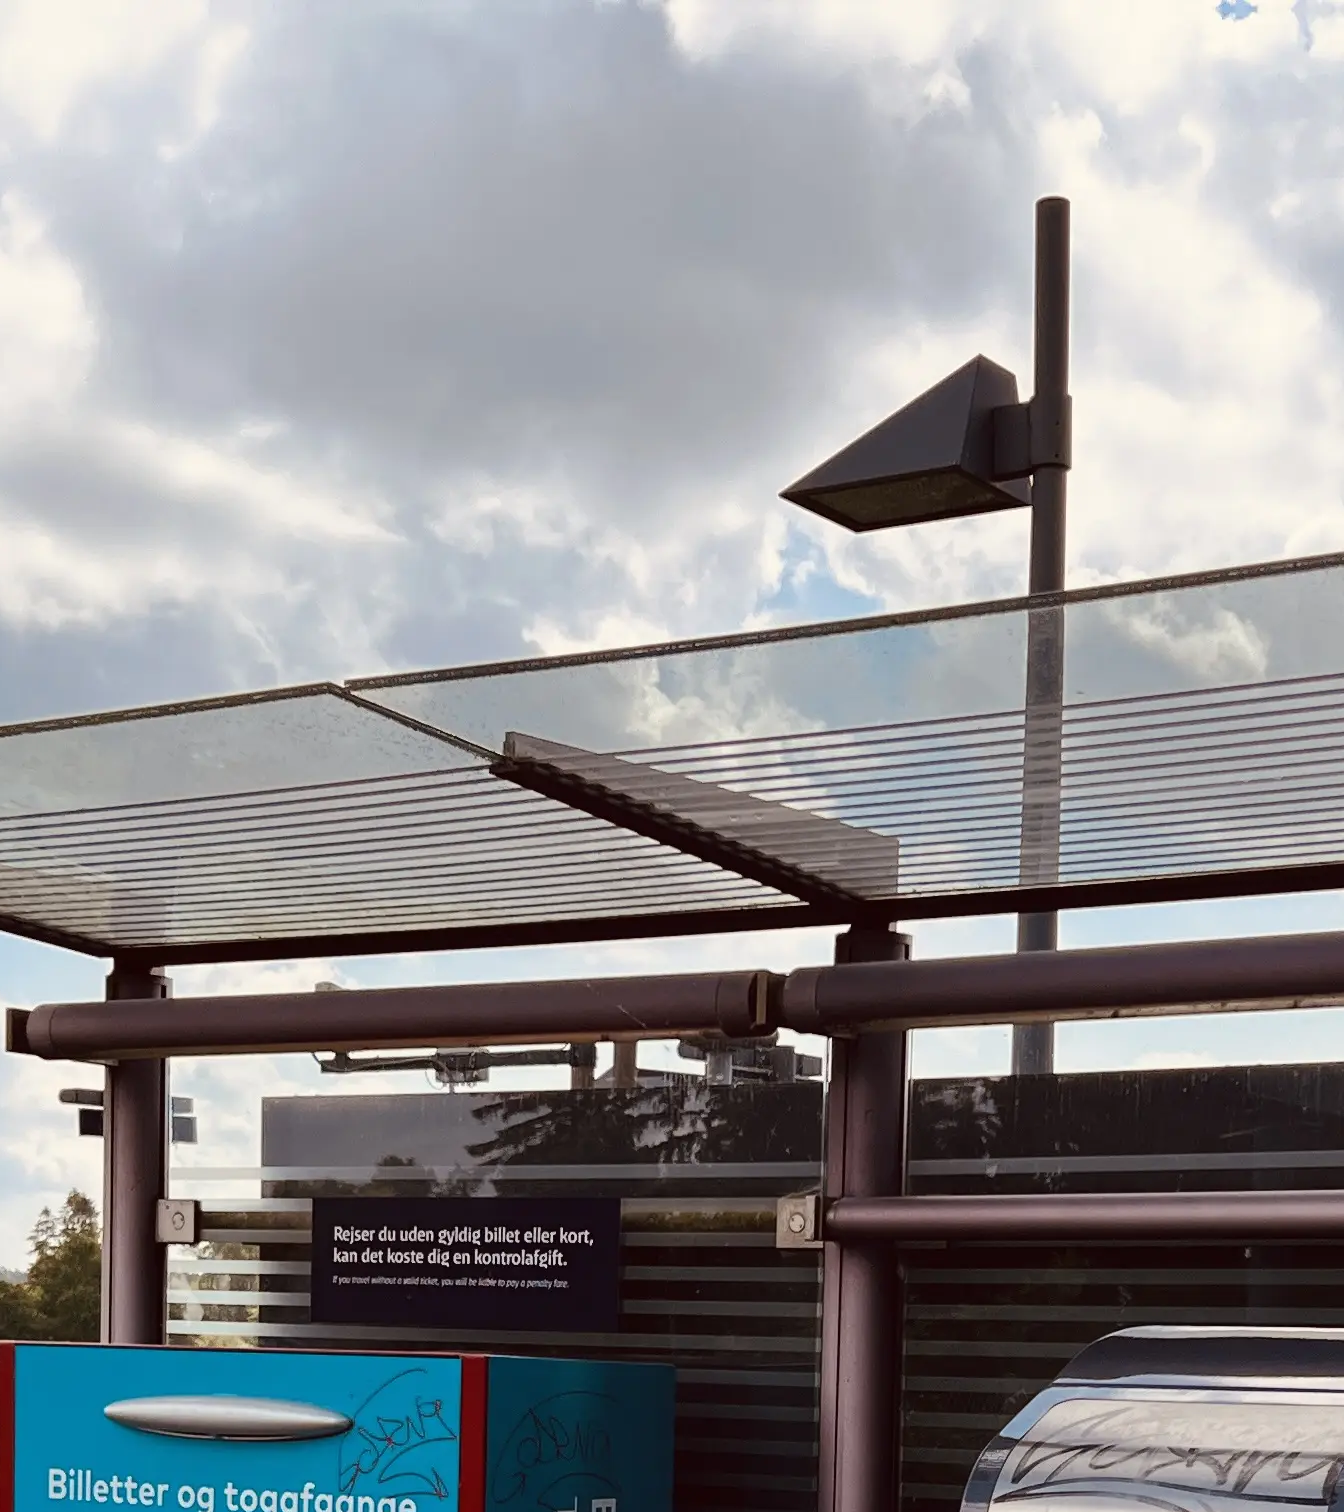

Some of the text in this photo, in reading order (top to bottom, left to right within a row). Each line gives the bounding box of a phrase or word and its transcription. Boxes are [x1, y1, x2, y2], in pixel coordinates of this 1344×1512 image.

[333, 1226, 594, 1246] Rejser du uden gyldig billet eller kort,
[333, 1248, 568, 1269] kan det koste dig en kontrolafgift.
[338, 1276, 351, 1285] you
[441, 1278, 454, 1287] you
[468, 1278, 477, 1286] be
[498, 1279, 506, 1287] to
[506, 1280, 519, 1289] pay
[47, 1468, 170, 1507] Billetter
